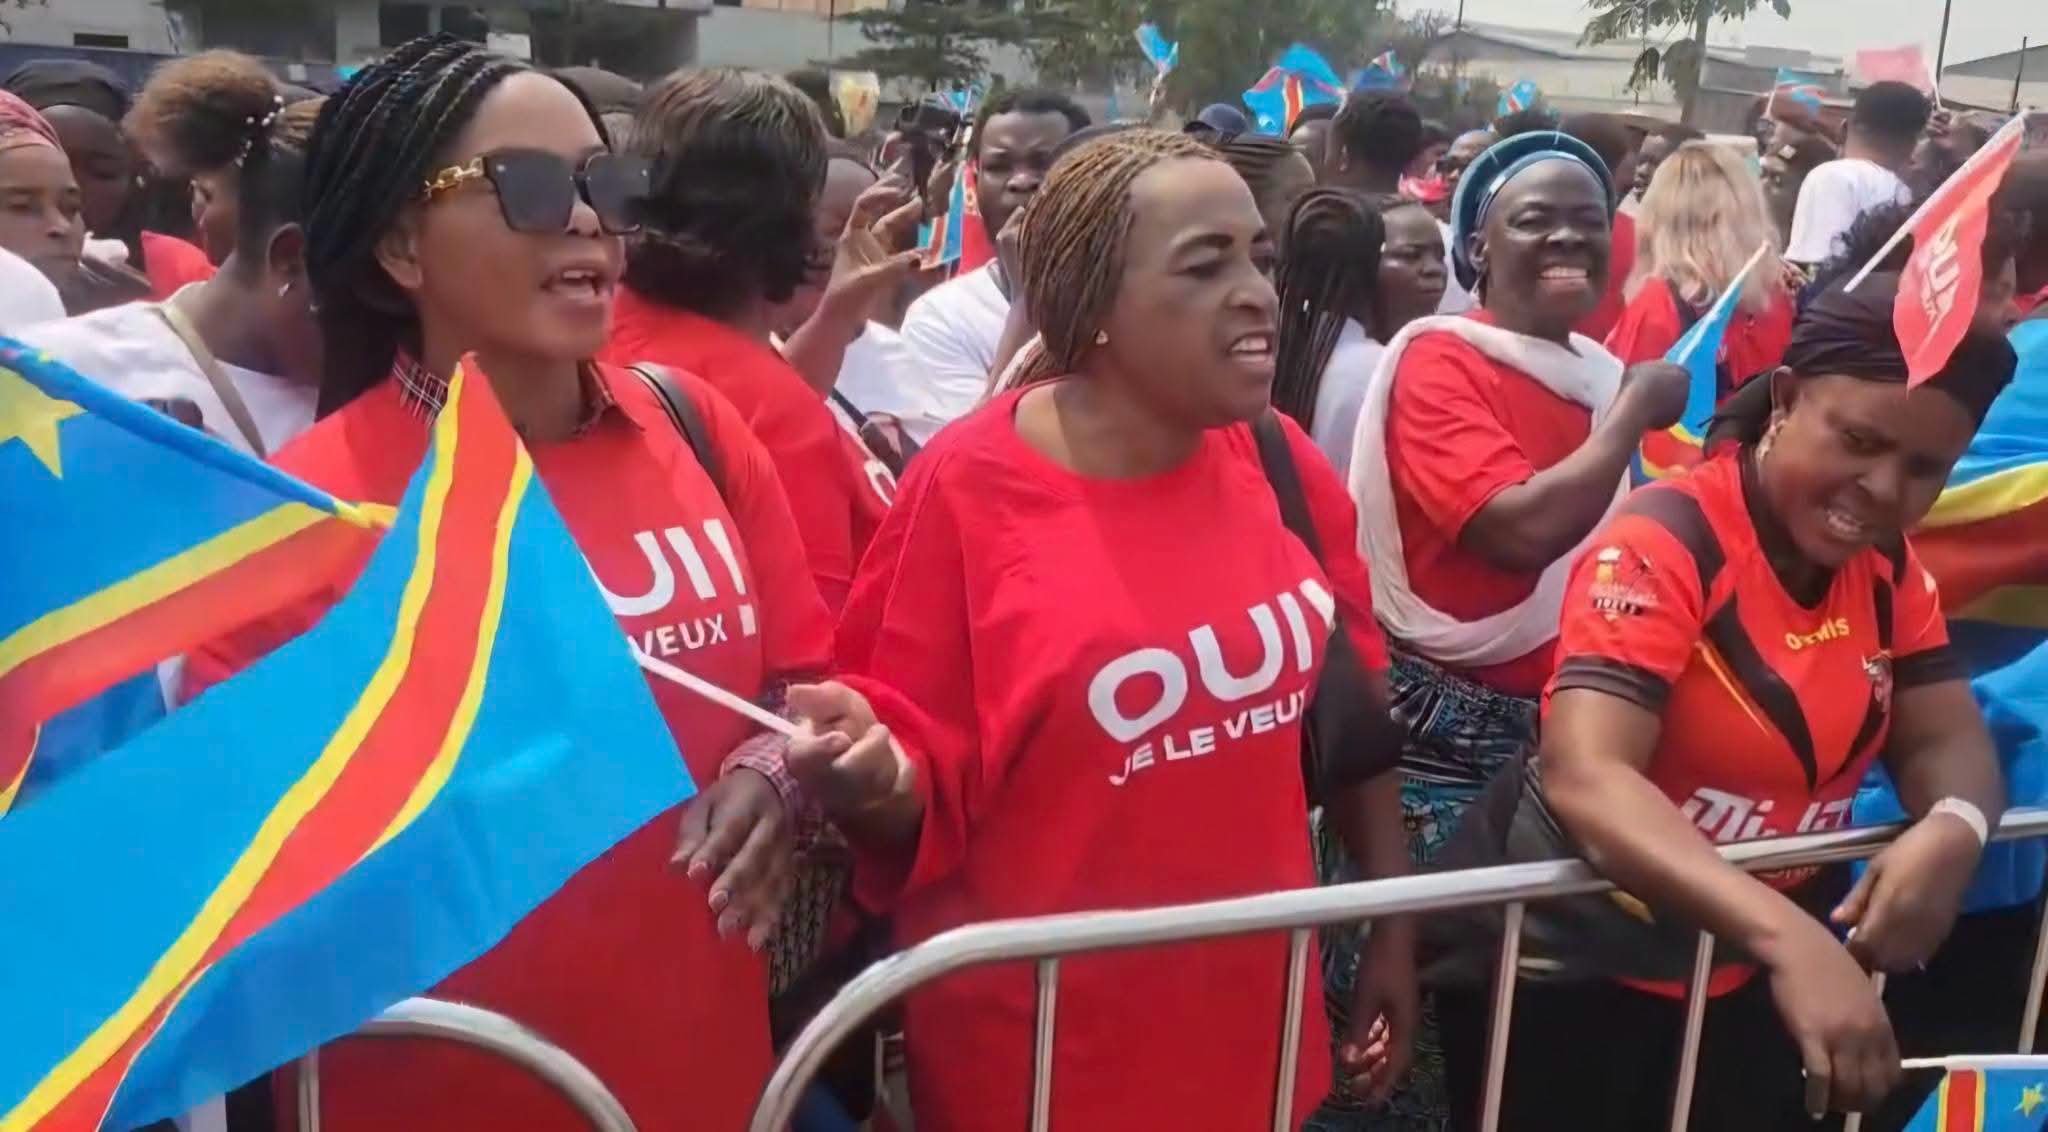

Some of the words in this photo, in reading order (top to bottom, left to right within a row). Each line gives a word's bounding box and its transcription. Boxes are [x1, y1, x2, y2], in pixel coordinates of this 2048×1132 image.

[579, 517, 757, 638] UI!
[1108, 742, 1156, 786] JE
[1162, 725, 1216, 761] LE
